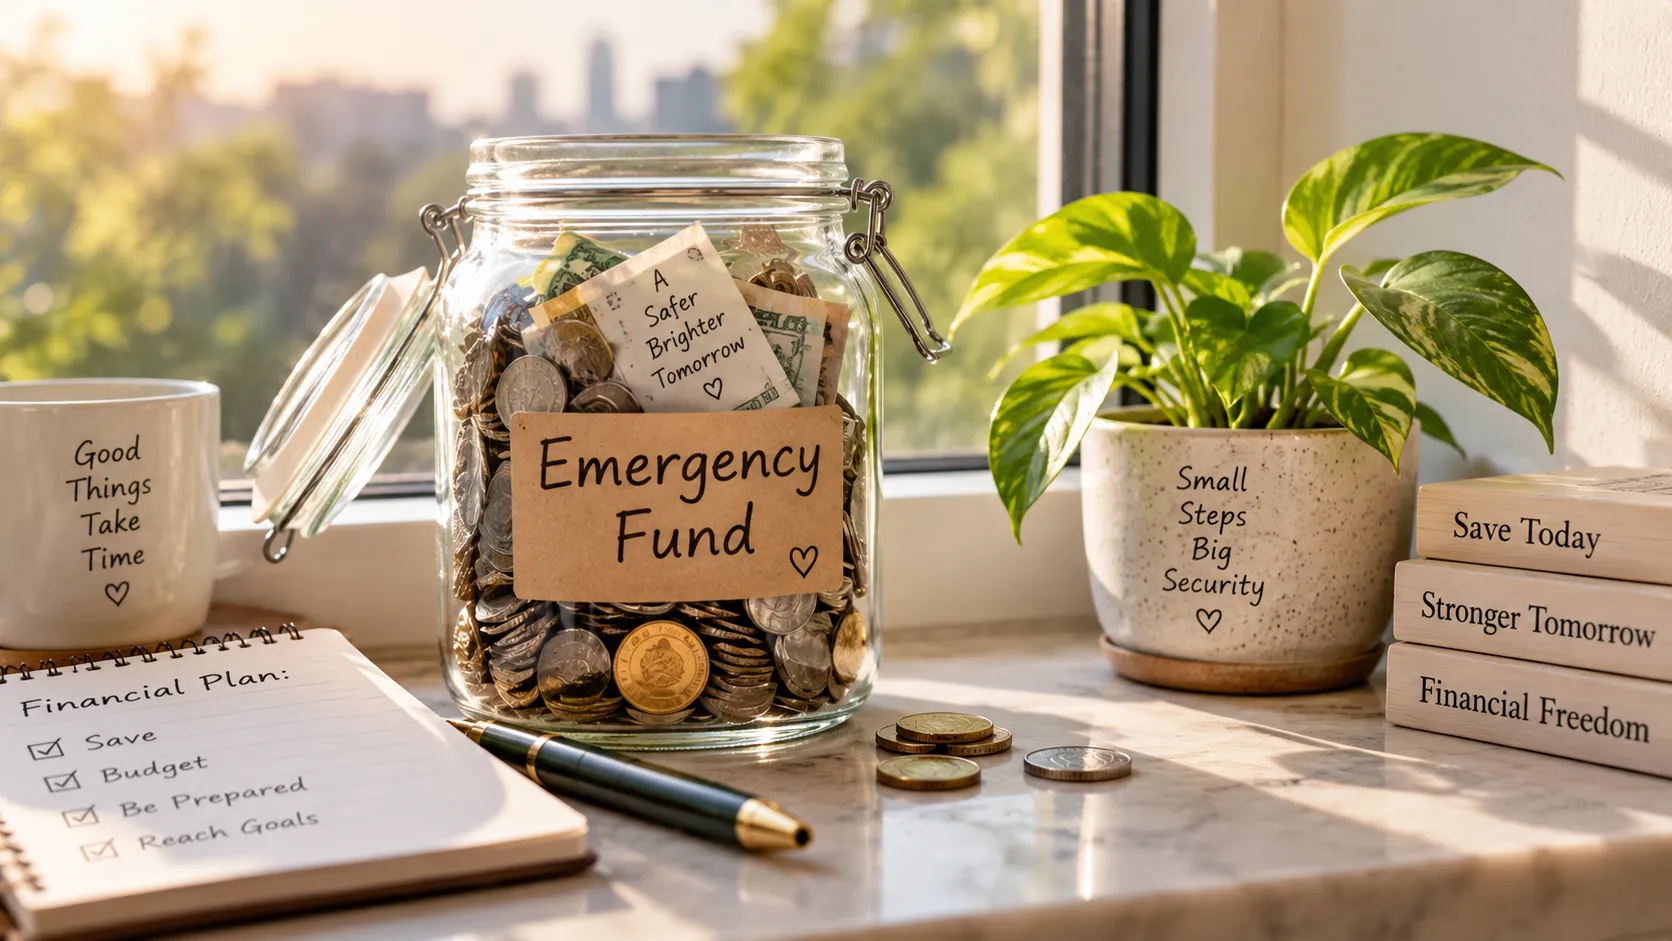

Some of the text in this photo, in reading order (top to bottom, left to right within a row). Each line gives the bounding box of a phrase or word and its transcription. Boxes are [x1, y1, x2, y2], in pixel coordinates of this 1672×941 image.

[654, 268, 669, 292] A
[645, 290, 698, 328] Safer
[645, 311, 725, 360] Brighter
[651, 337, 745, 389] Tomorrow
[74, 435, 141, 470] Good
[540, 436, 820, 504] Emergency
[66, 476, 151, 506] Things
[1176, 465, 1247, 493] Small
[81, 509, 140, 537] Take
[616, 501, 755, 563] Fund
[1178, 501, 1247, 533] Steps
[1453, 511, 1601, 559] Save Today
[81, 547, 145, 572] Time
[1192, 536, 1232, 570] Big
[1162, 568, 1265, 607] Security
[1421, 591, 1657, 649] Stronger Tomorrow
[21, 669, 289, 717] Financial Plan:
[1419, 676, 1649, 744] Financial Freedom
[85, 730, 157, 752] Save
[99, 756, 208, 784] Budget
[120, 777, 307, 819] Be Prepared
[138, 810, 319, 852] Reach Goals
